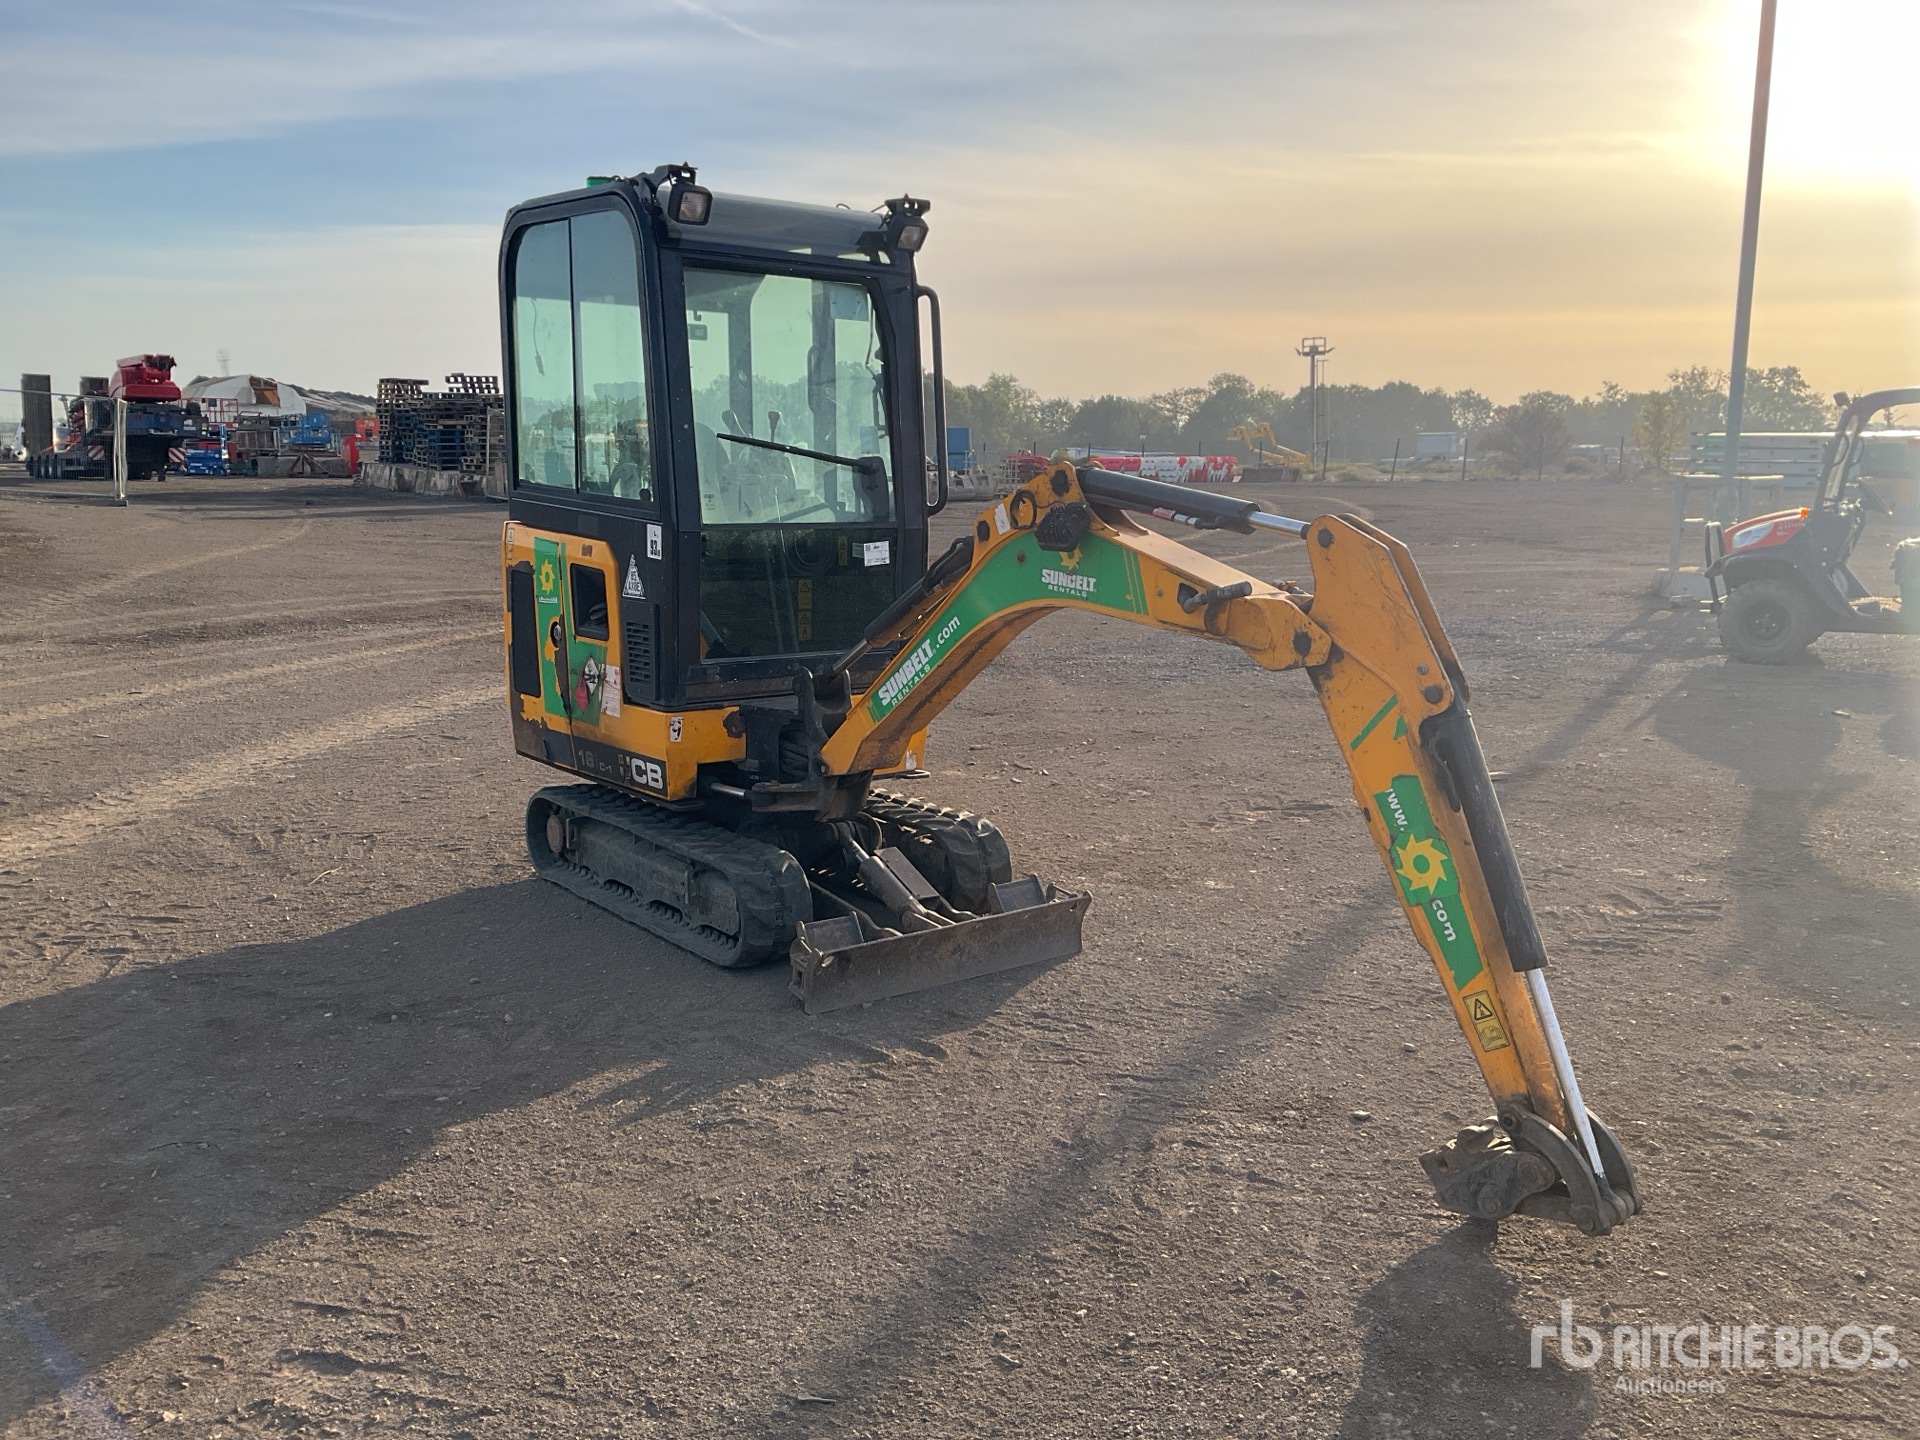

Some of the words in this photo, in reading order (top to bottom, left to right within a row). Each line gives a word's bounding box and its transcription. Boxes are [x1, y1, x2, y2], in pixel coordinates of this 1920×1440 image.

[1041, 568, 1097, 592] SUNBELT
[1047, 584, 1088, 597] RENTALS
[878, 638, 934, 706] SUNBELT
[891, 664, 931, 707] RENTALS
[1385, 788, 1409, 831] ww.
